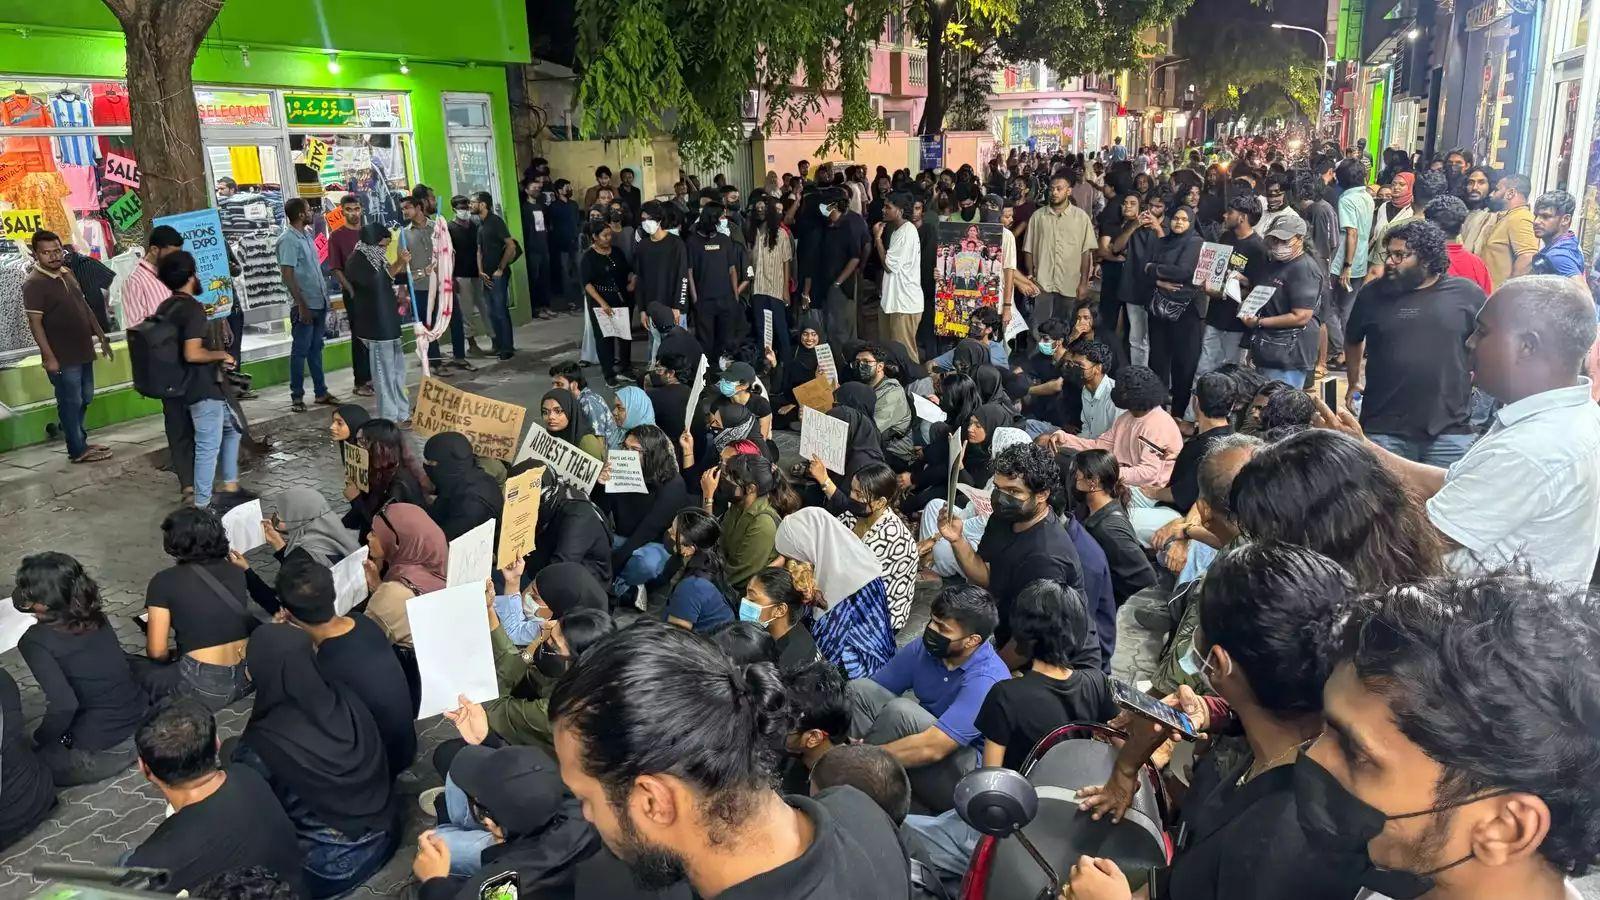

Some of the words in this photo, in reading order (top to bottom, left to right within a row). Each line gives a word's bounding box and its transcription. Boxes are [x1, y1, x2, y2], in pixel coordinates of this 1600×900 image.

[198, 104, 265, 118] SELECTION
[310, 140, 325, 171] SALE
[107, 158, 140, 183] SALE
[112, 195, 142, 228] SALE
[4, 214, 42, 235] SALE
[181, 226, 216, 241] ATIONS
[192, 236, 218, 250] EXPO
[430, 405, 437, 417] 6
[441, 409, 472, 427] YEARS
[473, 443, 509, 459] DAYS?
[529, 431, 569, 466] ARREST
[565, 450, 598, 484] THEM
